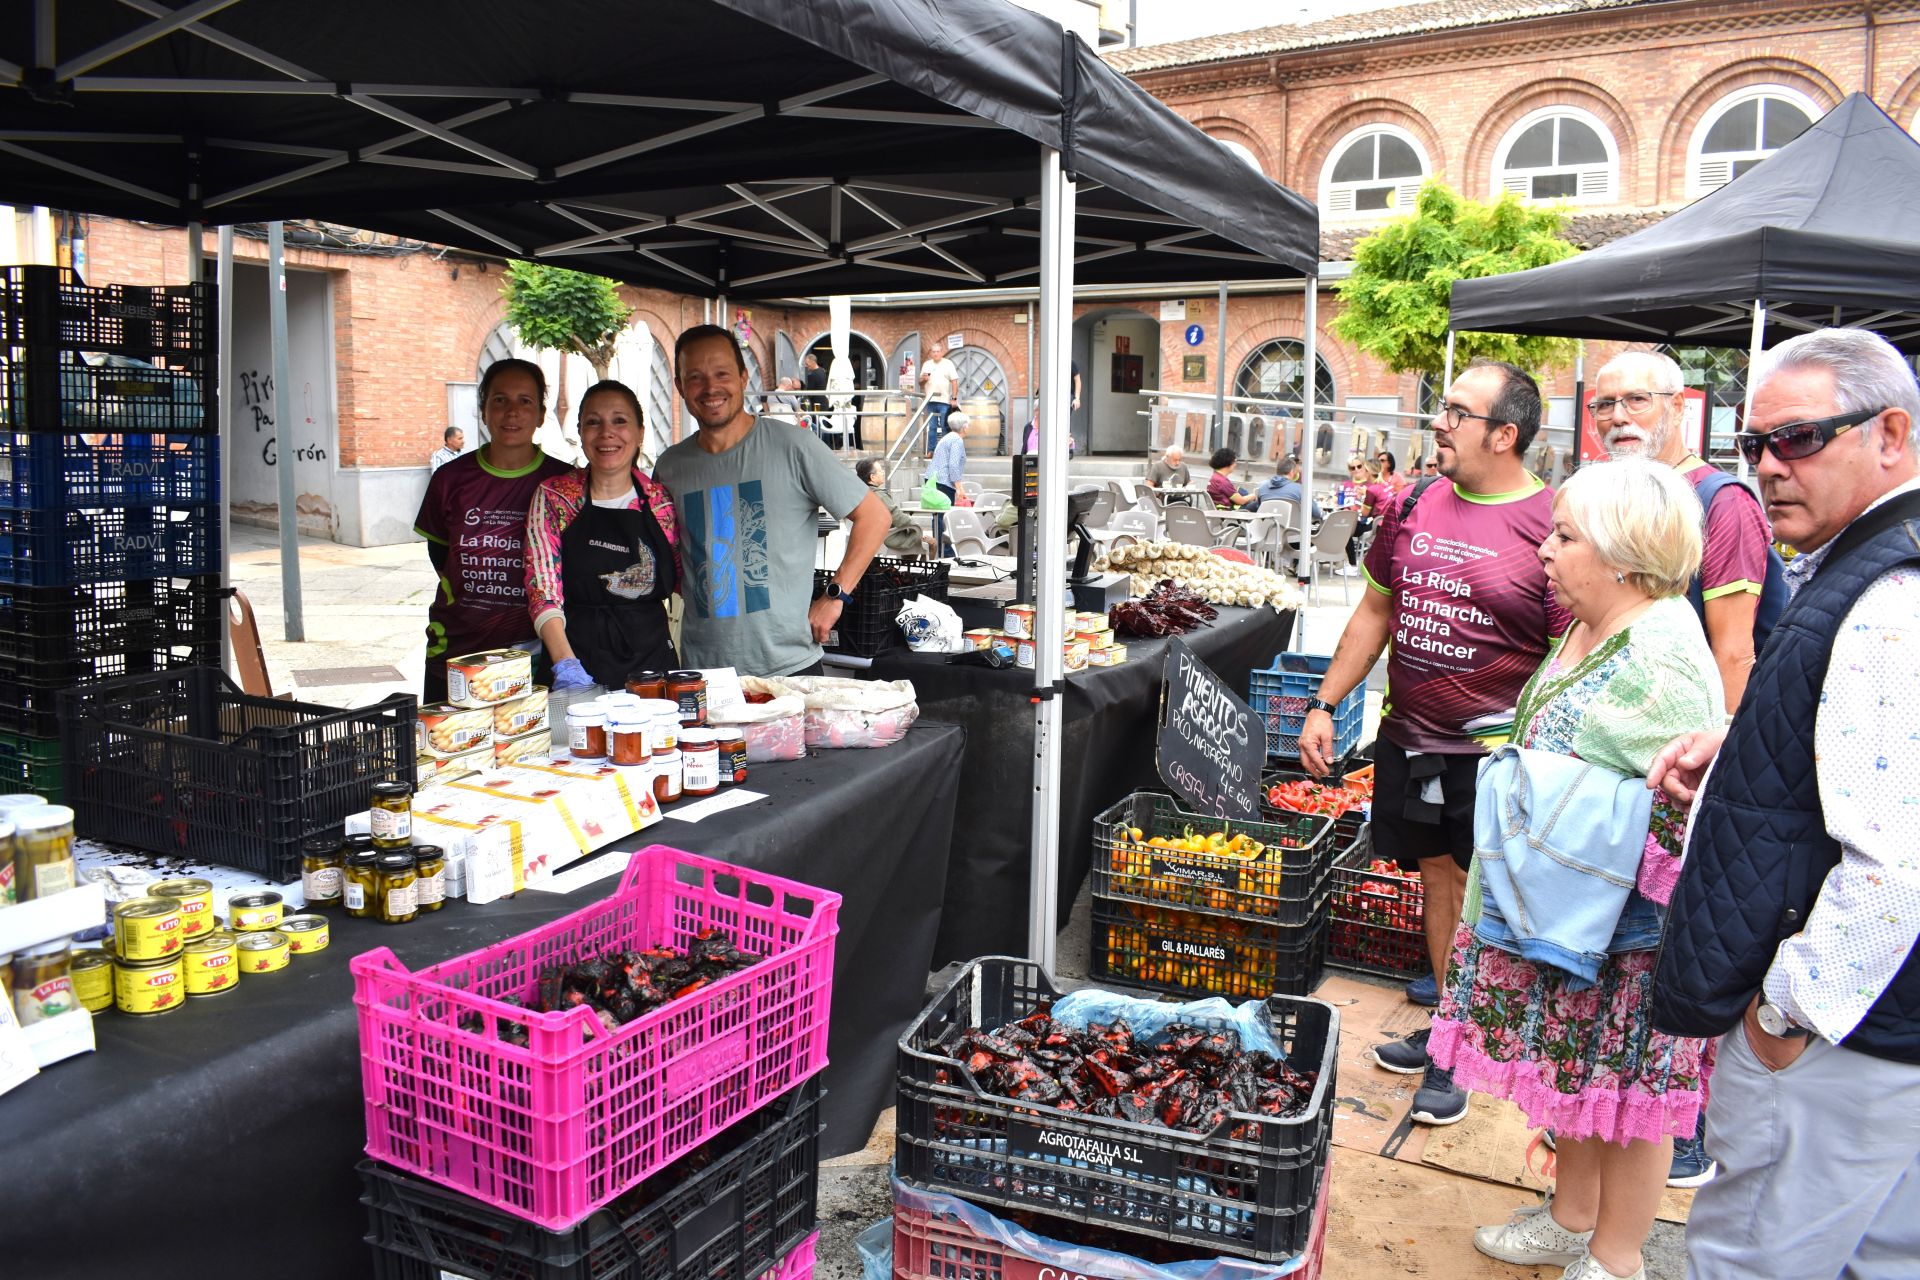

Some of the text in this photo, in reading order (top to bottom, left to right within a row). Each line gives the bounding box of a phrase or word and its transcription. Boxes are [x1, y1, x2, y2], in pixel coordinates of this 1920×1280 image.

[263, 437, 326, 466] Grón
[112, 463, 158, 477] RADVI
[114, 535, 162, 550] RADVI
[460, 534, 521, 551] La Rioja
[460, 553, 525, 568] En marc
[1440, 552, 1448, 560] La
[461, 569, 507, 581] contra
[1402, 566, 1471, 598] La Rioja
[464, 580, 527, 597] el cáncer
[1402, 590, 1494, 626] En marcha
[1400, 612, 1451, 637] contra
[1396, 629, 1408, 645] el
[1411, 634, 1477, 660] cáncer
[1178, 652, 1249, 746] PIMIENTOS
[1180, 692, 1231, 756] ASADOS
[159, 918, 179, 931] LITO
[1161, 940, 1226, 960] GIL & PALLARÉS
[207, 956, 229, 967] LITO
[151, 974, 175, 986] LITO
[1038, 1131, 1144, 1164] AGROTAFALLA S.L.
[1067, 1148, 1113, 1167] MAGAN
